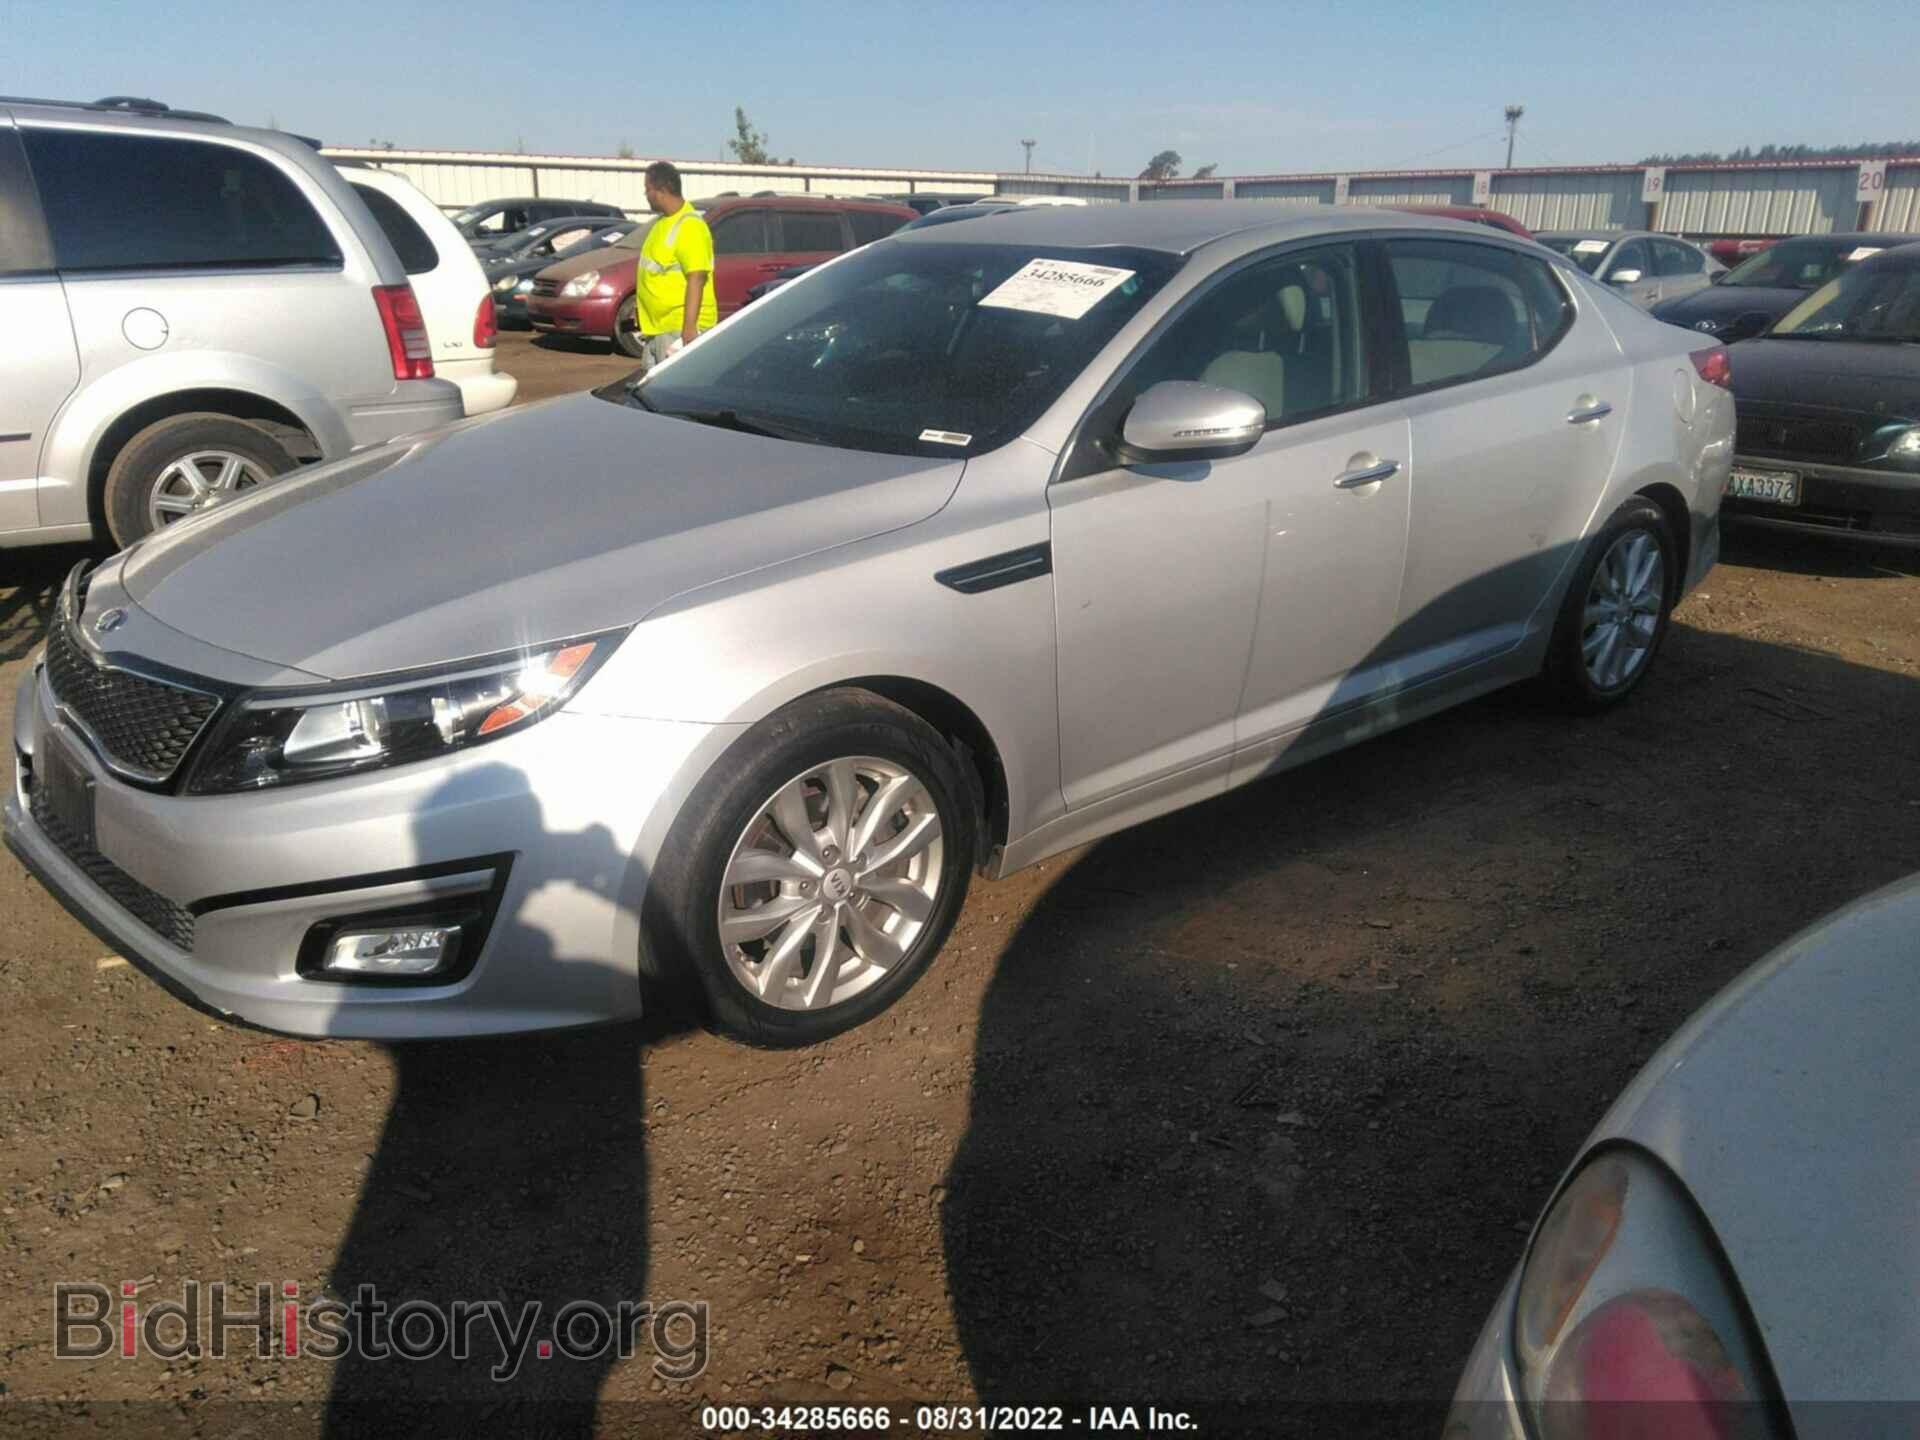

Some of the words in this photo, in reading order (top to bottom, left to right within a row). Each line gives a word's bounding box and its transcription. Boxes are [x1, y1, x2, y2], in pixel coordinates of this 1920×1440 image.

[1647, 176, 1660, 192] 19
[1859, 171, 1882, 191] 20
[1025, 268, 1106, 287] 34285666
[1728, 474, 1793, 500] AXA3372
[831, 872, 847, 896] KIA
